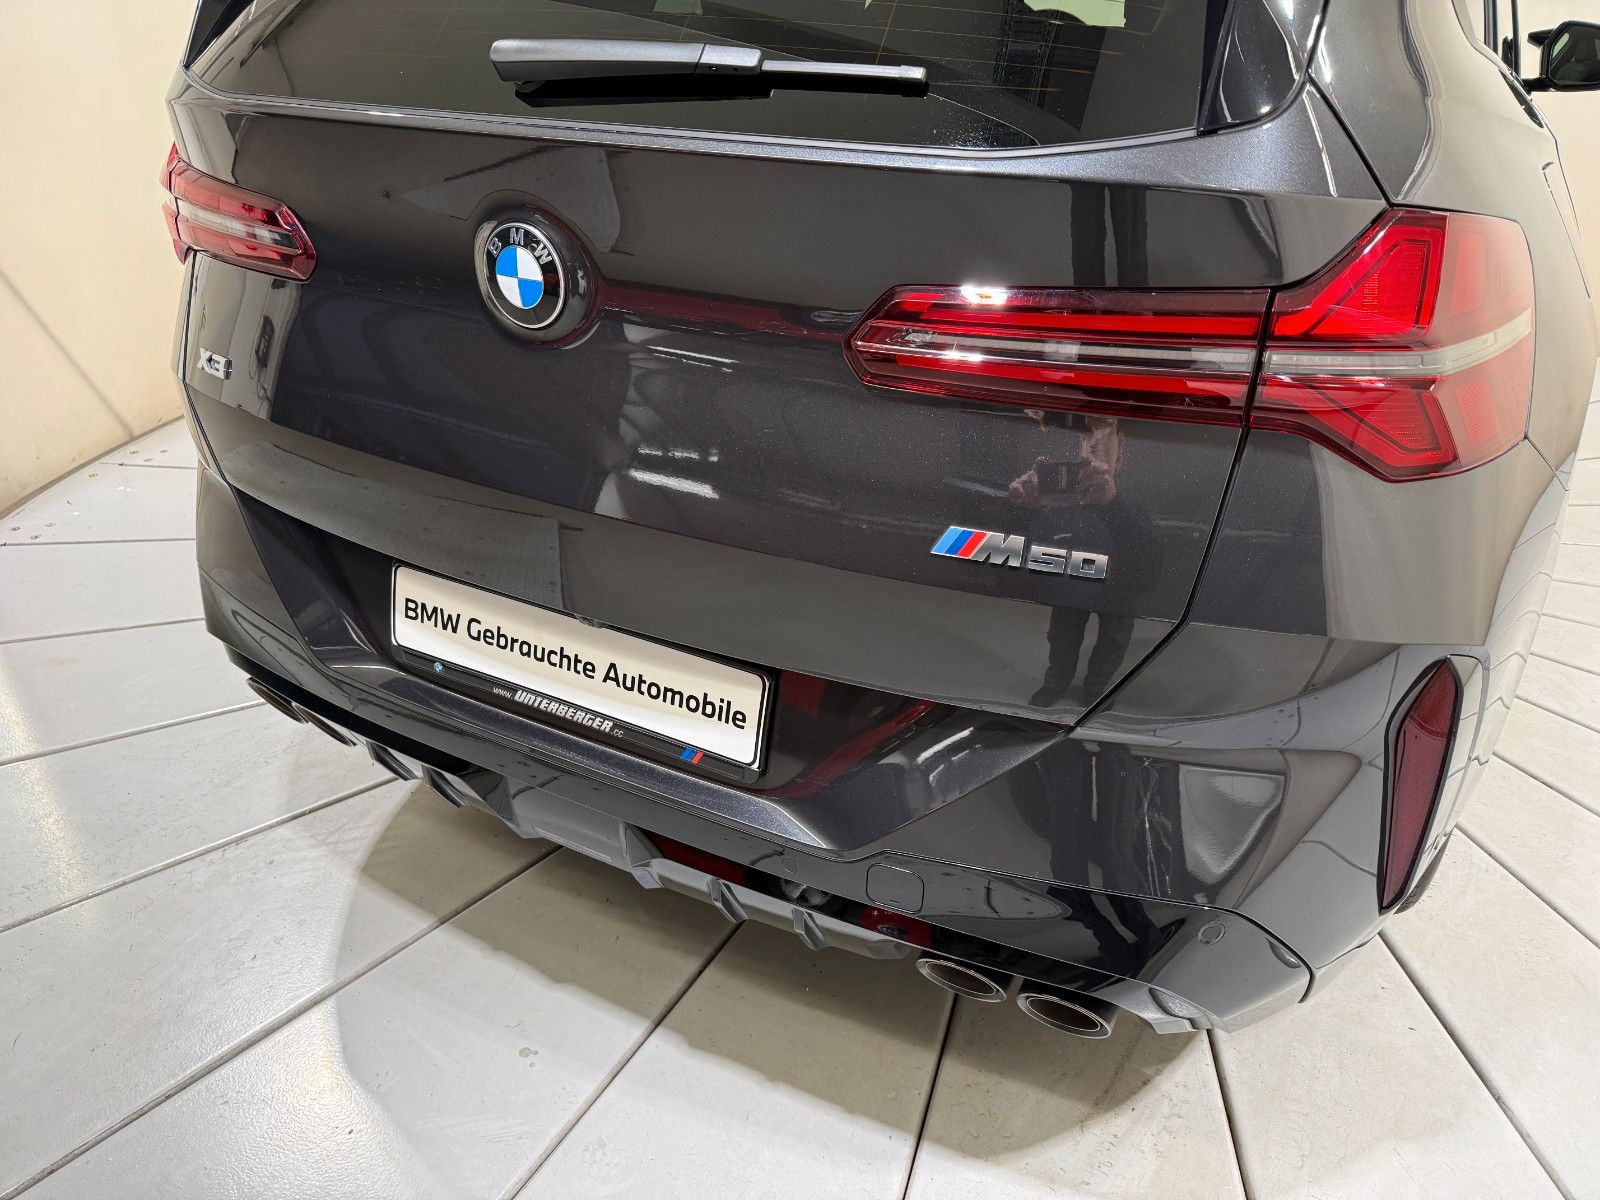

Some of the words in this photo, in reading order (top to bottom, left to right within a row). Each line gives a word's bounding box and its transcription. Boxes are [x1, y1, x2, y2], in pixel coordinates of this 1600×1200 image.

[487, 227, 552, 265] BMW
[970, 533, 1108, 579] M50
[404, 598, 461, 634] BMW
[467, 617, 596, 679] Gebrauchte
[602, 662, 747, 729] Automobile
